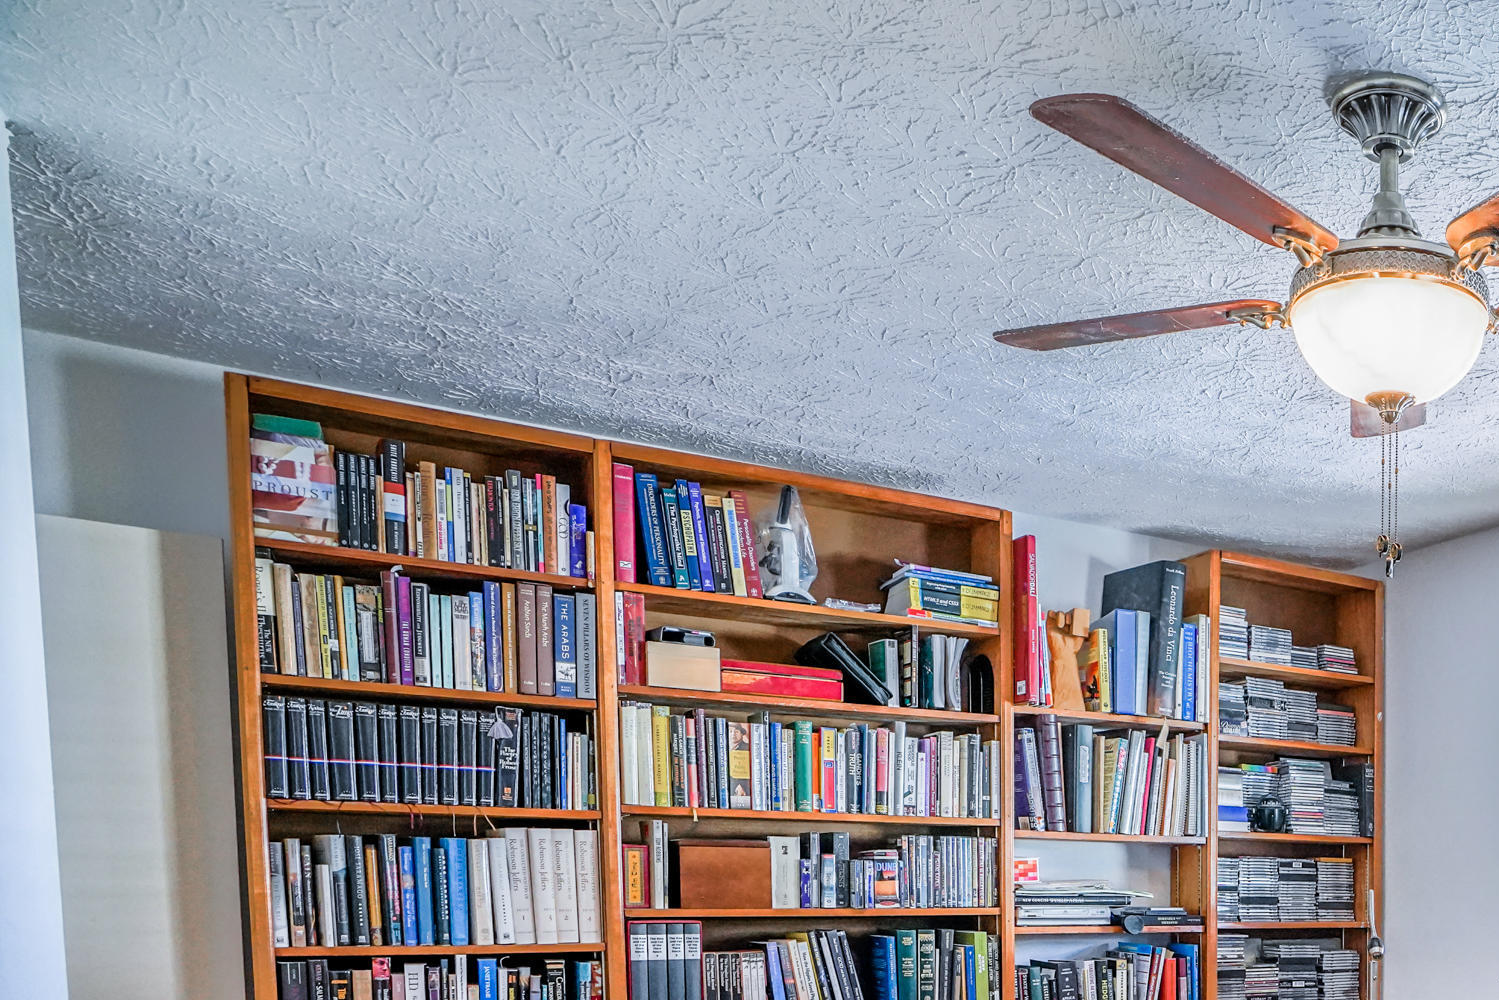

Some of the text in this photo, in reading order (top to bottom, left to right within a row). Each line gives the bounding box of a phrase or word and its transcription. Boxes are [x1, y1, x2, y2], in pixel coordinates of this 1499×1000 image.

[390, 444, 398, 458] SUITE
[253, 480, 333, 500] PROUST
[511, 489, 522, 552] IRON COPPER SKY
[646, 483, 665, 566] DISORDERS PERSONALITY
[669, 506, 684, 567] The Psychopathic Mind
[681, 511, 695, 555] PSYCHOPATHY
[737, 527, 746, 548] Modern
[716, 525, 725, 560] CLASSIFICATION
[742, 518, 757, 571] Personality Disorders
[255, 566, 266, 600] Roget's
[939, 598, 949, 607] and
[257, 616, 267, 659] Thesaurus
[523, 599, 532, 638] Arabian Sands
[560, 602, 570, 660] THE ARABS
[1165, 585, 1179, 663] Leonardo da Vinci
[264, 628, 272, 653] The NEW
[402, 630, 410, 648] HUMAN
[583, 652, 590, 661] OF
[403, 647, 411, 672] CONDITION
[1185, 641, 1194, 703] BIOCHEMISTRY
[303, 854, 312, 879] CAIN
[354, 862, 363, 899] SARAMAGO
[509, 838, 520, 892] Robinson Jeffers
[538, 838, 548, 891] Robinson Jeffers
[554, 840, 565, 892] Robinson Jeffers
[578, 840, 590, 892] Robinson Jeffers
[875, 862, 897, 871] DUNE
